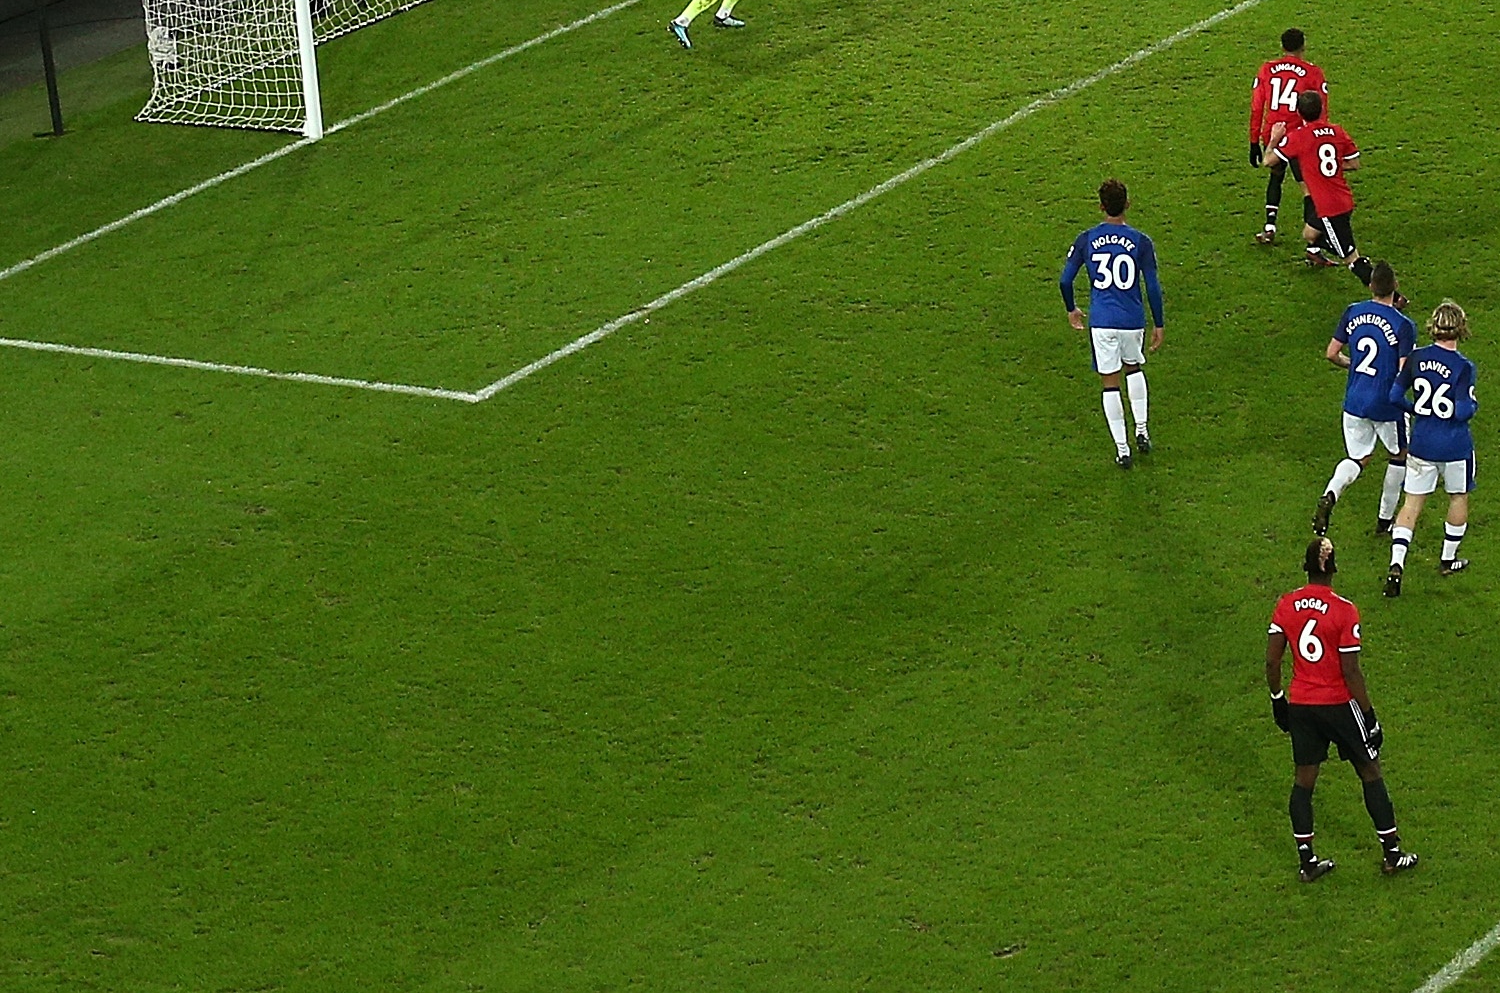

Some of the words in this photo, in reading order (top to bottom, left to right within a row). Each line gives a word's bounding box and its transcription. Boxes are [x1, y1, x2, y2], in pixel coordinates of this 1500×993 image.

[1270, 63, 1307, 77] LINGARD
[1269, 77, 1298, 112] 14
[1318, 143, 1338, 177] 8
[1091, 234, 1136, 252] HOLGATE
[1091, 253, 1136, 290] 30
[1345, 313, 1399, 346] SCHNEIDERLIN
[1355, 336, 1378, 377] 2
[1419, 360, 1452, 379] DAVIES
[1413, 377, 1455, 419] 26
[1294, 597, 1329, 615] POGBA
[1298, 618, 1324, 663] 6
